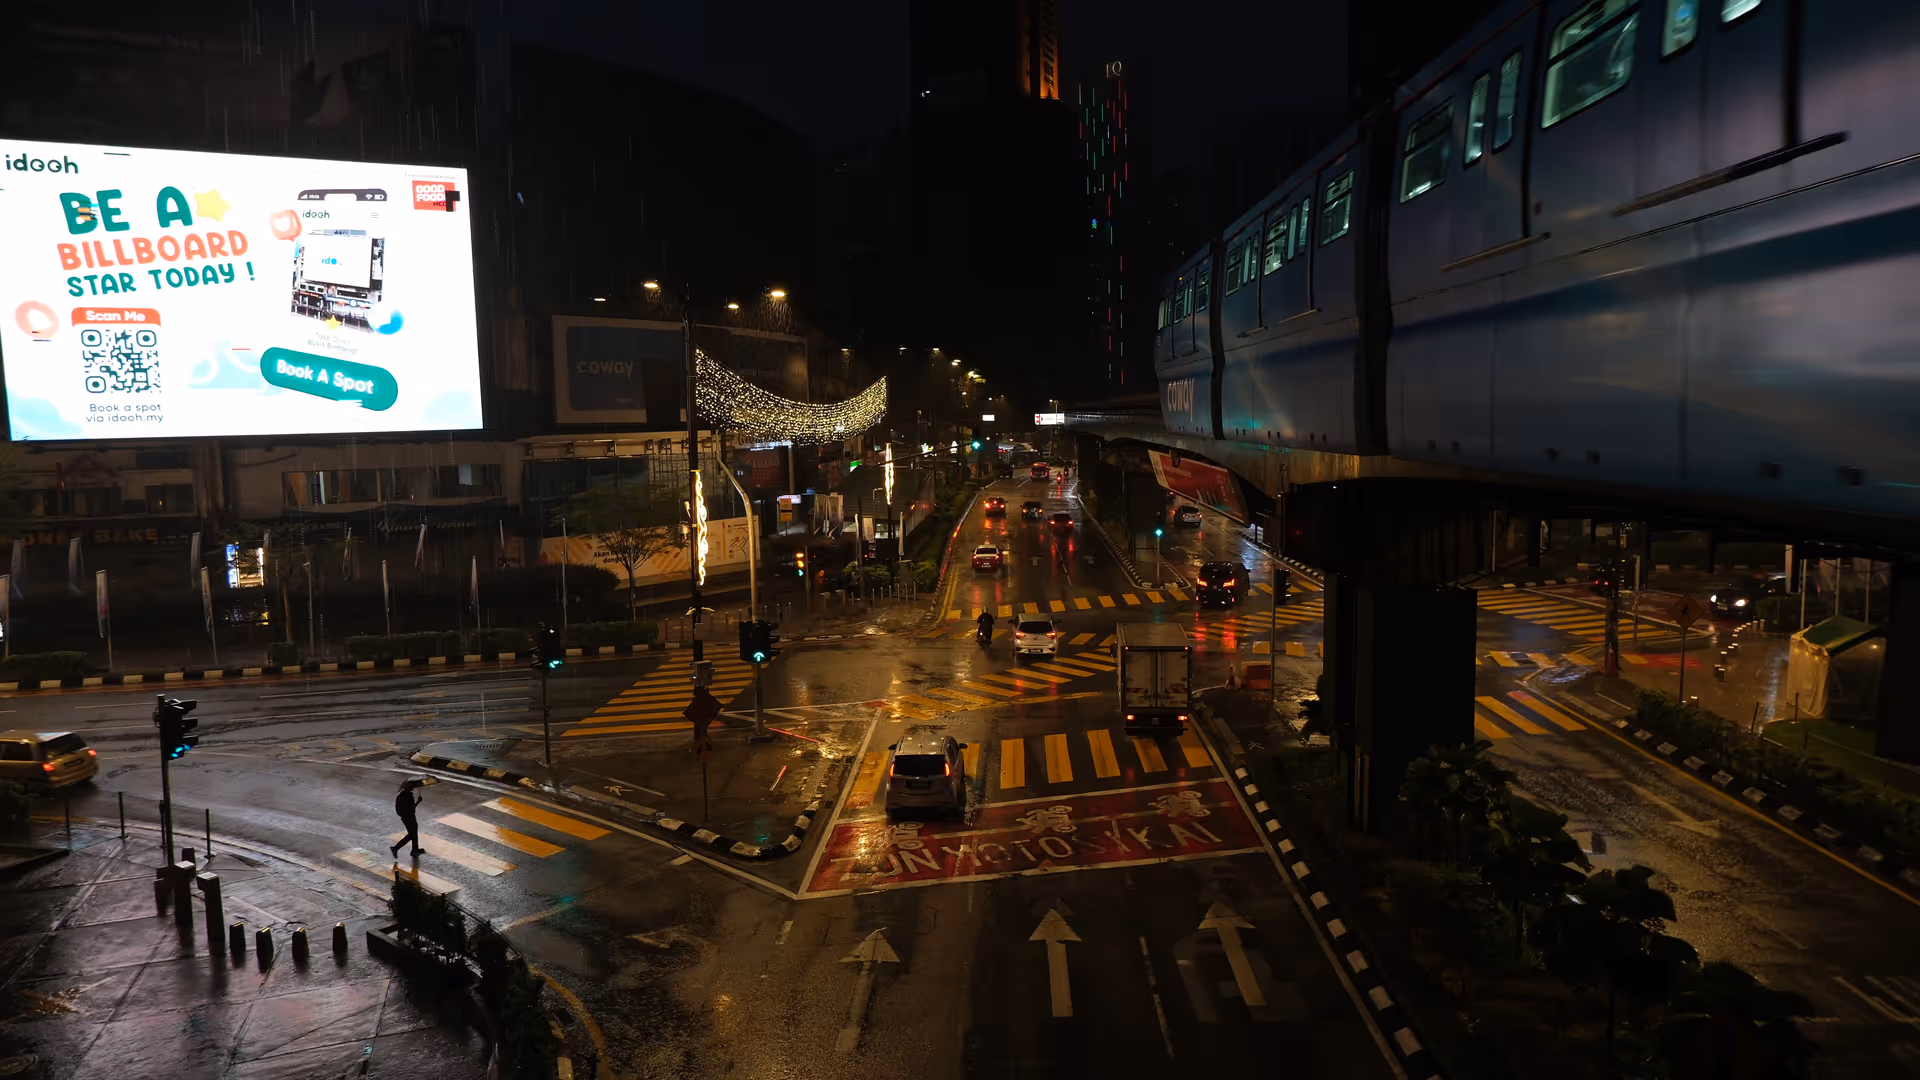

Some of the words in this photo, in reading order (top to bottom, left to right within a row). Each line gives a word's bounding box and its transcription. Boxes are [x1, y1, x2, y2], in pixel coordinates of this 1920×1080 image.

[5, 153, 79, 174] idooh
[415, 184, 446, 194] GOOD
[59, 188, 130, 235] BE
[156, 186, 193, 228] A
[302, 209, 330, 219] idooh
[56, 230, 248, 271] BILLBOARD
[67, 272, 137, 297] STAR
[147, 263, 235, 290] TODAY
[85, 310, 121, 321] Scan
[124, 311, 146, 321] Me
[276, 359, 314, 381] Book
[316, 368, 329, 384] A
[333, 371, 375, 395] Spot
[576, 360, 634, 380] coway
[89, 403, 120, 412] Book
[123, 404, 131, 412] a
[135, 404, 162, 413] spot
[1167, 377, 1195, 421] coway
[85, 413, 104, 422] via
[108, 413, 164, 423] idooh.my
